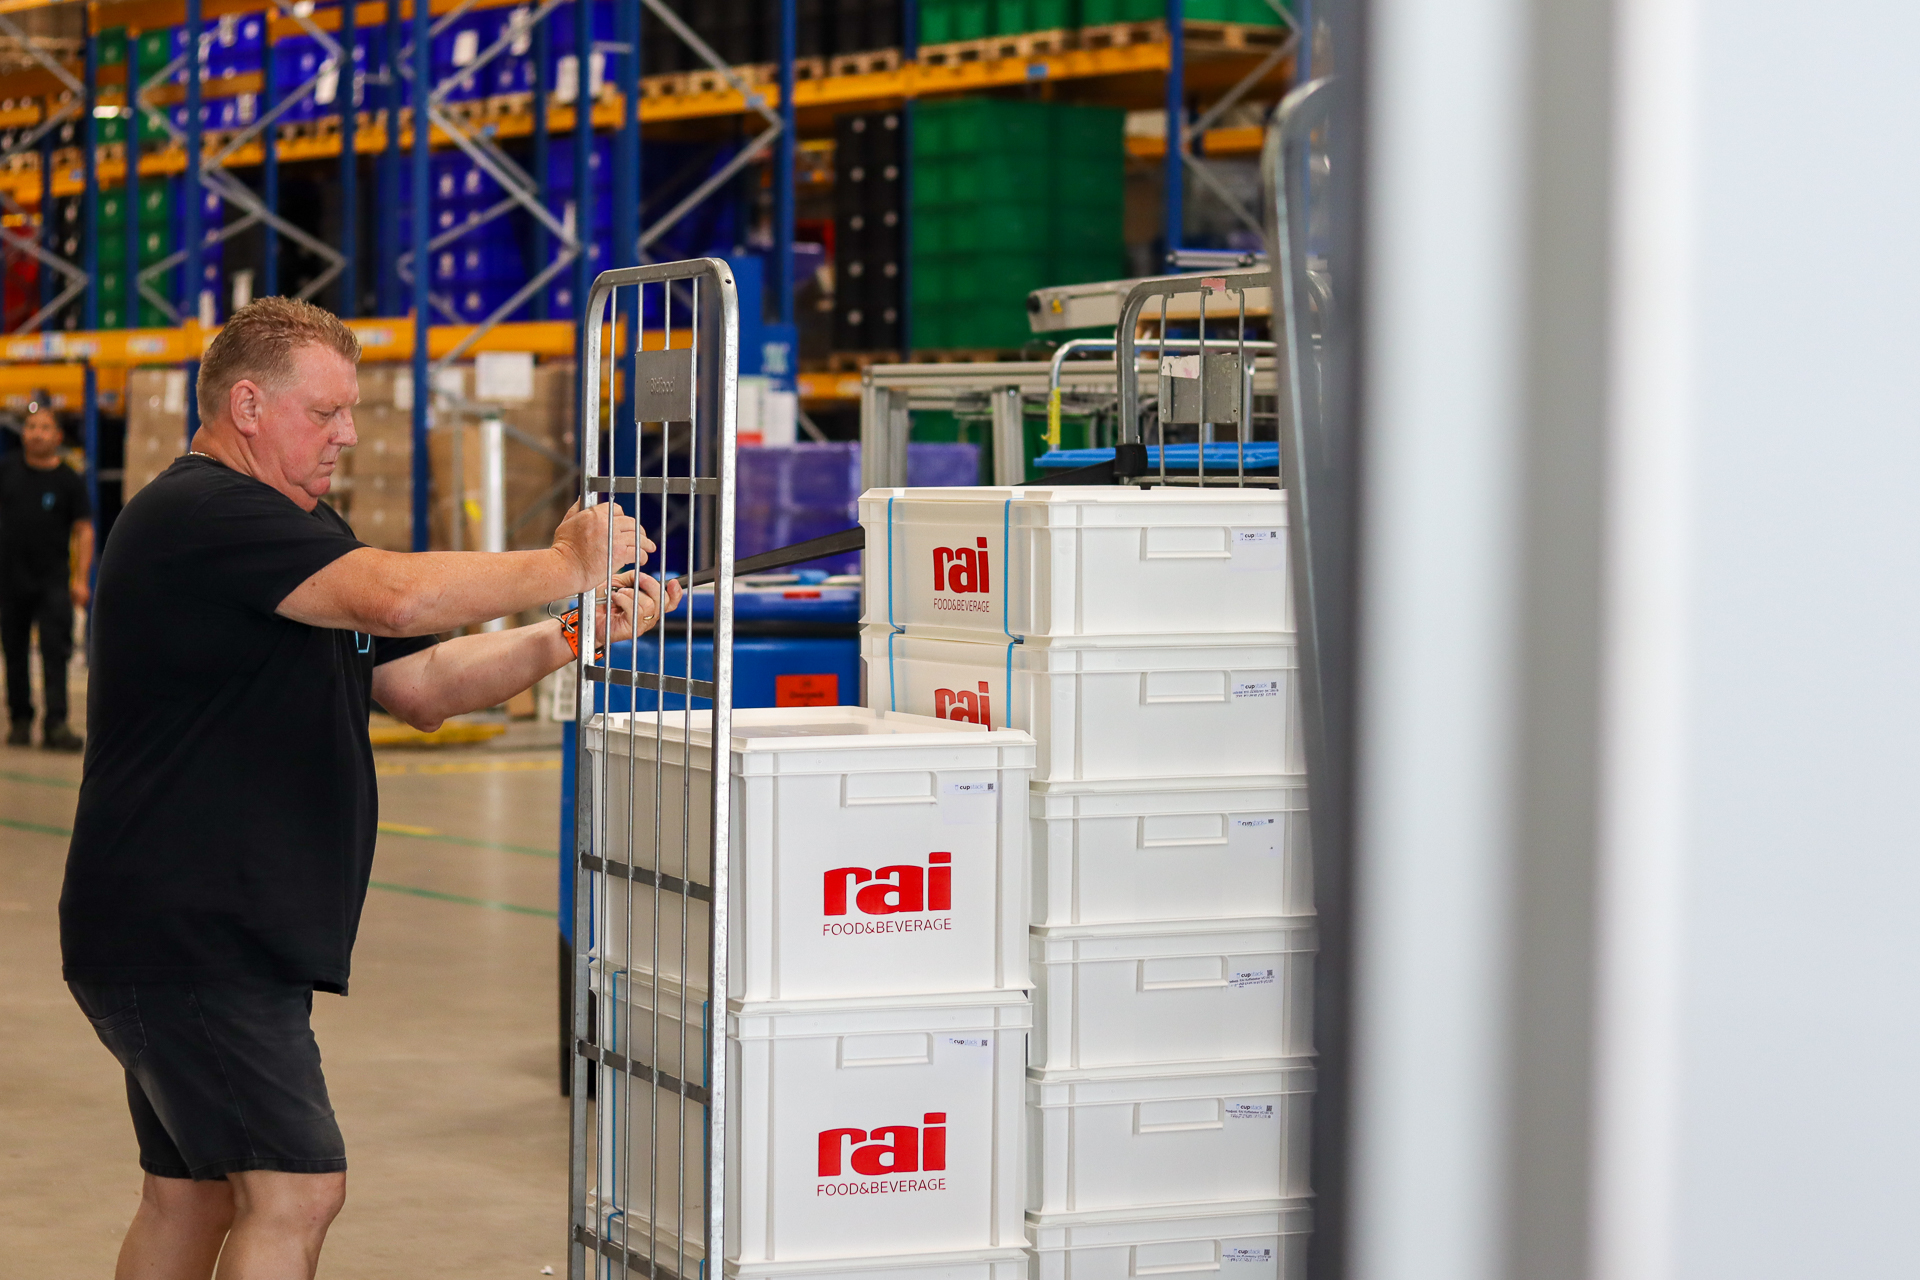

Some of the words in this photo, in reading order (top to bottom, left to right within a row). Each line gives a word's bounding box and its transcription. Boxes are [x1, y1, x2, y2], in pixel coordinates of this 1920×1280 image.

[933, 536, 989, 594] rai
[933, 598, 990, 613] FOOD&BEVERAGE
[934, 680, 991, 732] rai
[823, 851, 951, 916] rai
[822, 918, 952, 937] FOOD&BEVERAGE
[818, 1111, 946, 1177] rai
[816, 1178, 946, 1197] FOOD&BEVERAGE
